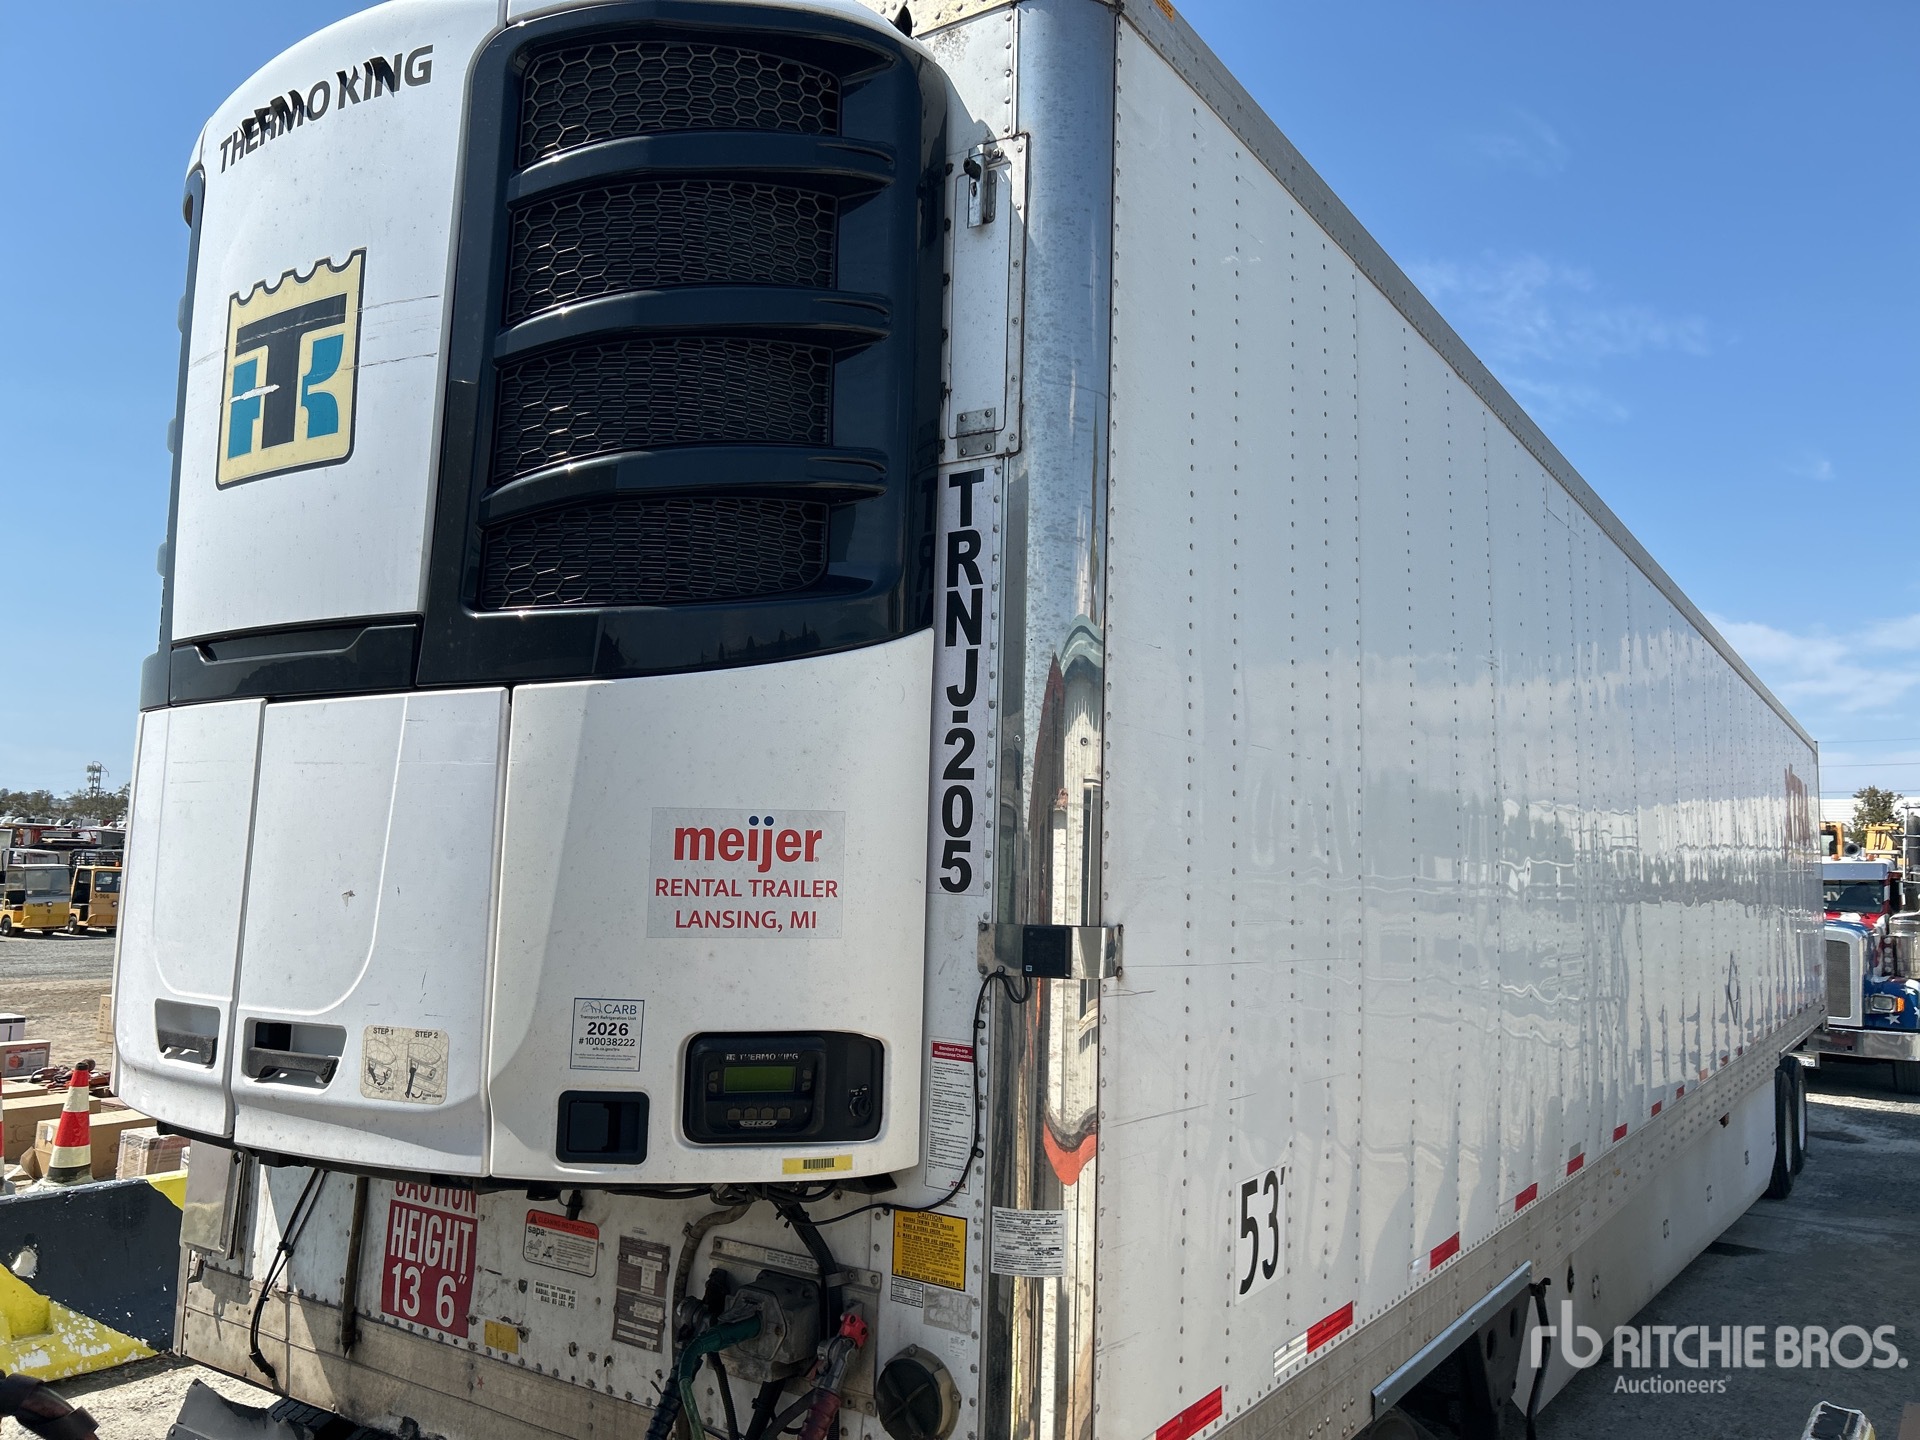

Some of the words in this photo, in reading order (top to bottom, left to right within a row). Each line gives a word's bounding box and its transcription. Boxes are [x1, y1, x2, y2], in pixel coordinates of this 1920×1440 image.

[219, 80, 331, 174] THERMO
[335, 44, 434, 110] KING
[673, 815, 823, 873] meijer
[655, 878, 743, 897] RENTAL
[748, 879, 838, 898] TRAILER
[675, 910, 783, 933] LANSING,
[789, 911, 817, 929] MI
[604, 1003, 637, 1015] CARB
[373, 1027, 389, 1035] STEP
[415, 1030, 433, 1039] STEP
[587, 1021, 629, 1036] 2026
[949, 1180, 966, 1189] XTA
[917, 1211, 944, 1223] CAUTION
[390, 1206, 474, 1275] HEIGHT
[392, 1262, 426, 1318] 13'
